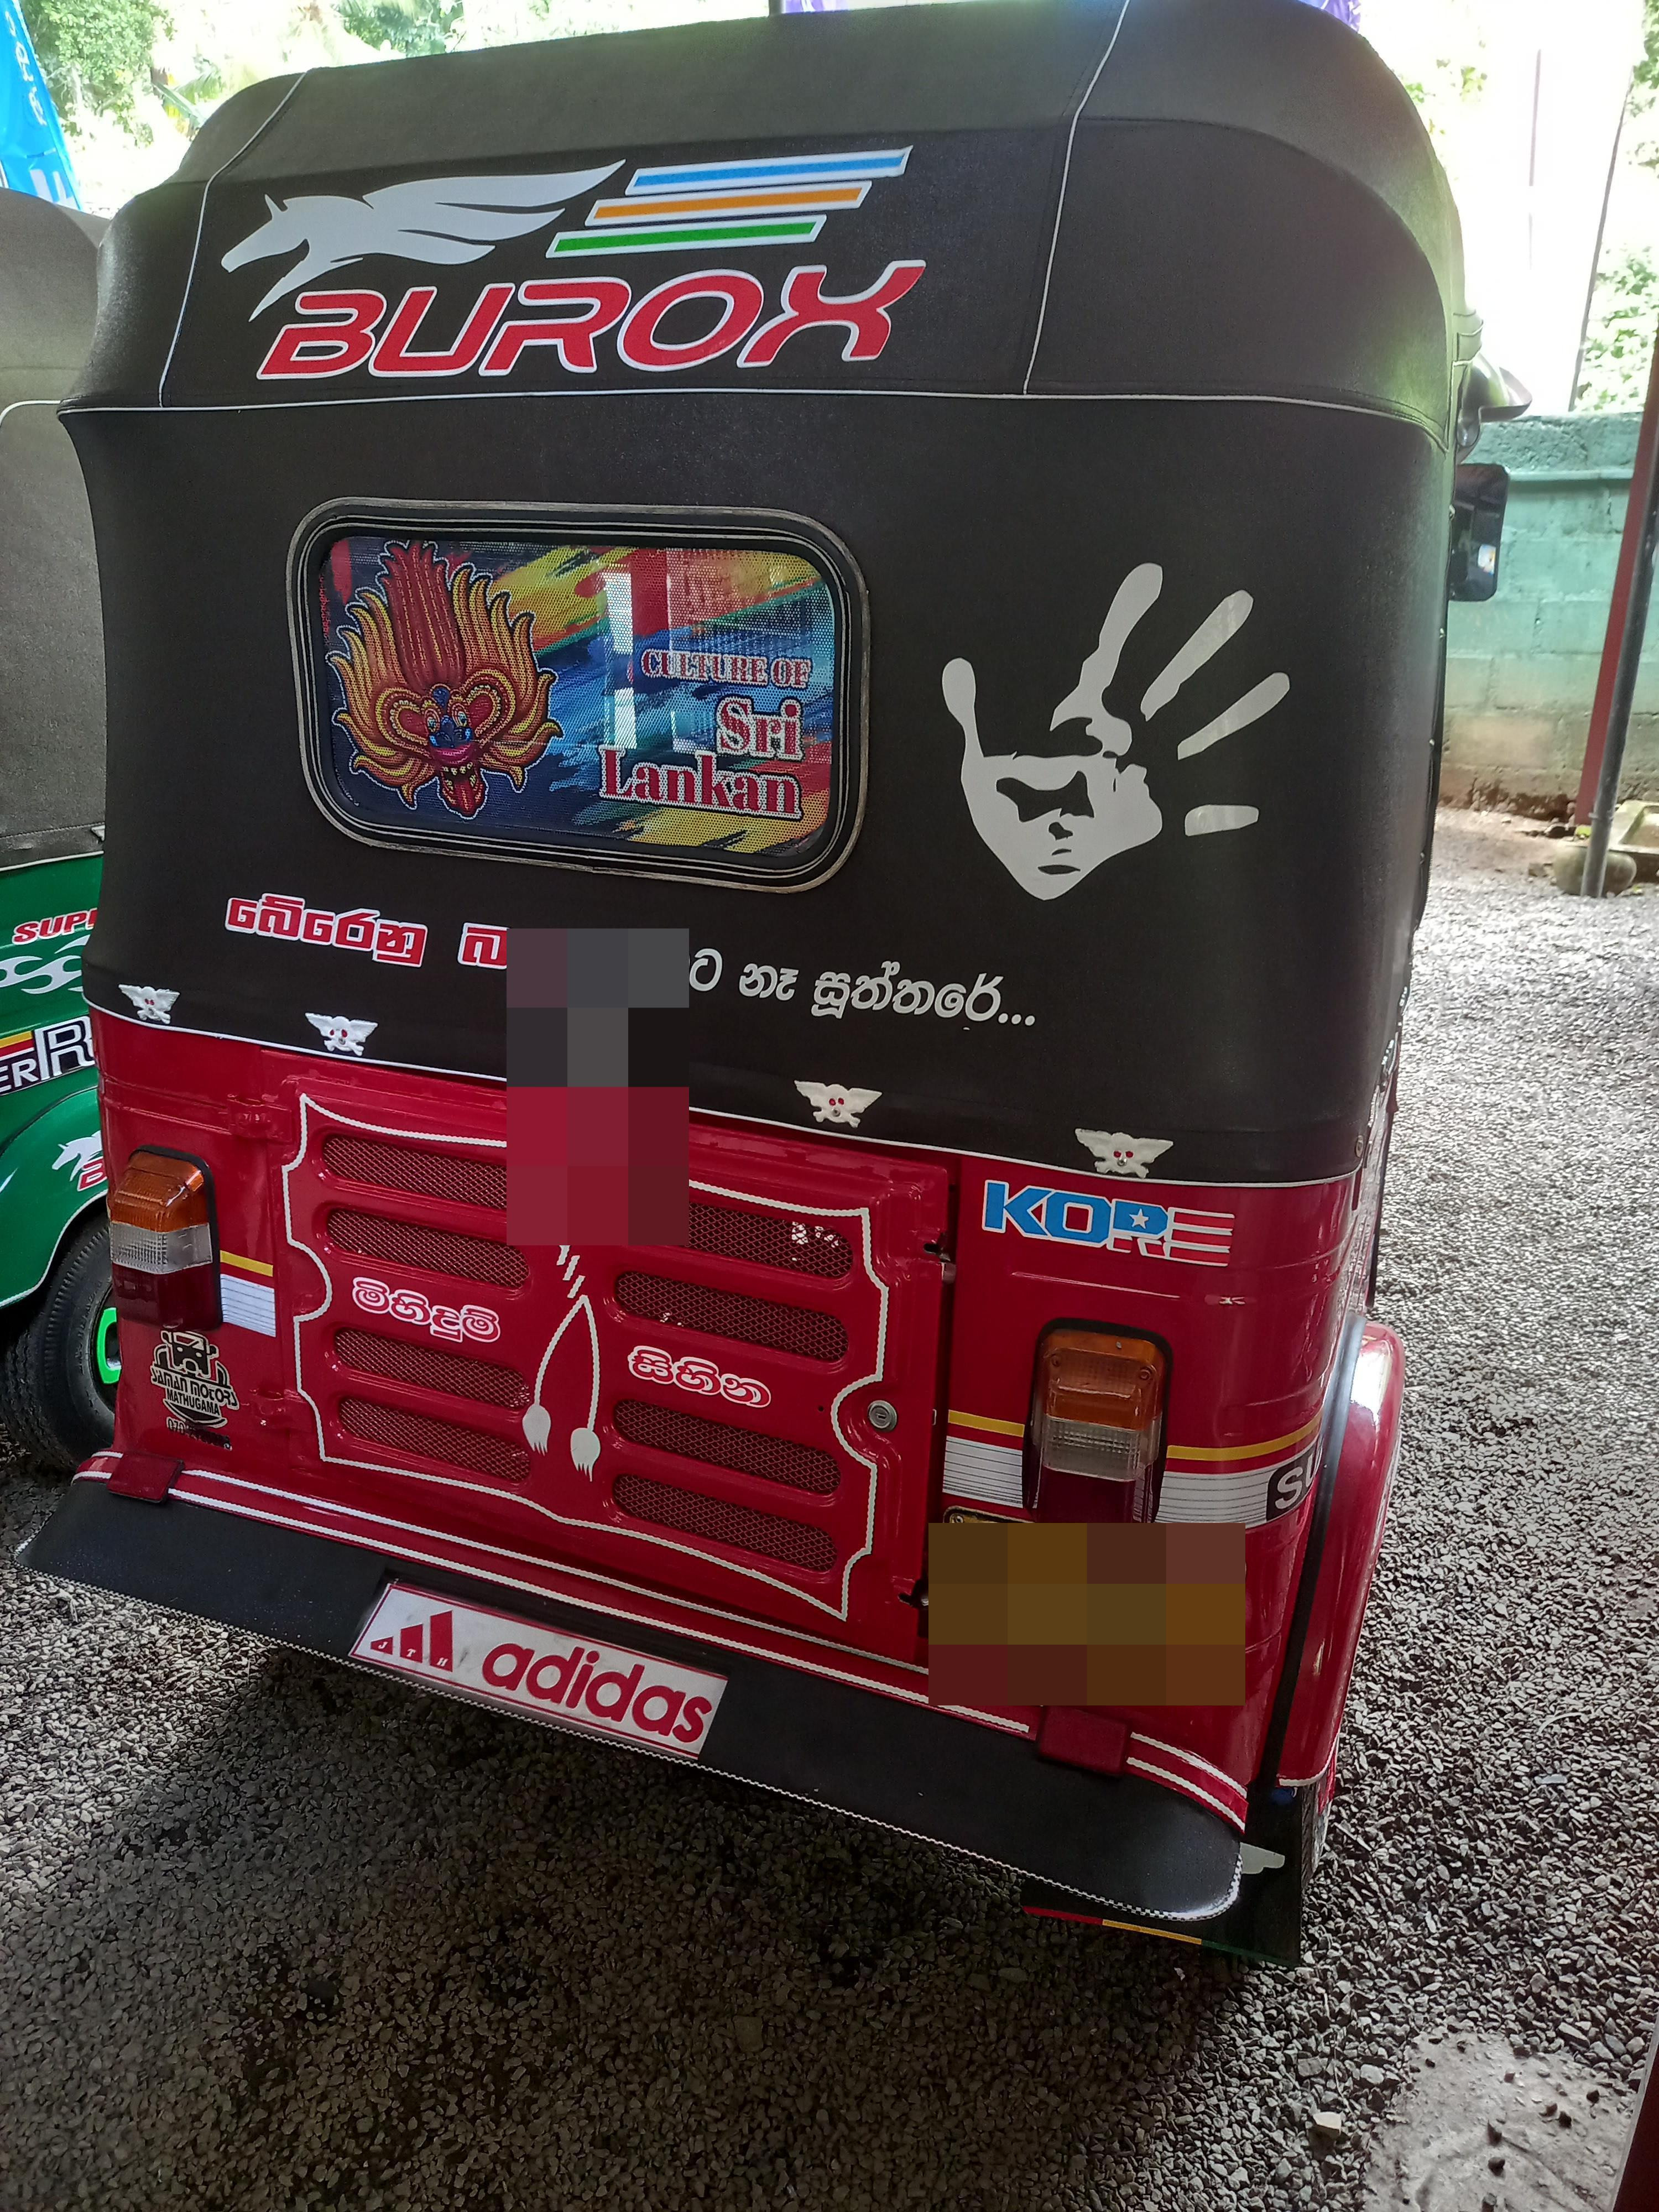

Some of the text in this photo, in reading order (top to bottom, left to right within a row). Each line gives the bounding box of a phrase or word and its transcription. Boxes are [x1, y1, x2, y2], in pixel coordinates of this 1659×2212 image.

[257, 259, 927, 379] BUROX
[641, 649, 811, 688] CULTURE OF
[717, 696, 804, 760] Sri
[598, 745, 803, 820] Lankan
[982, 1180, 1235, 1266] KORE
[166, 1387, 220, 1416] MATHUGAMA
[627, 1345, 771, 1408] සිහින
[482, 1643, 712, 1743] adidas
